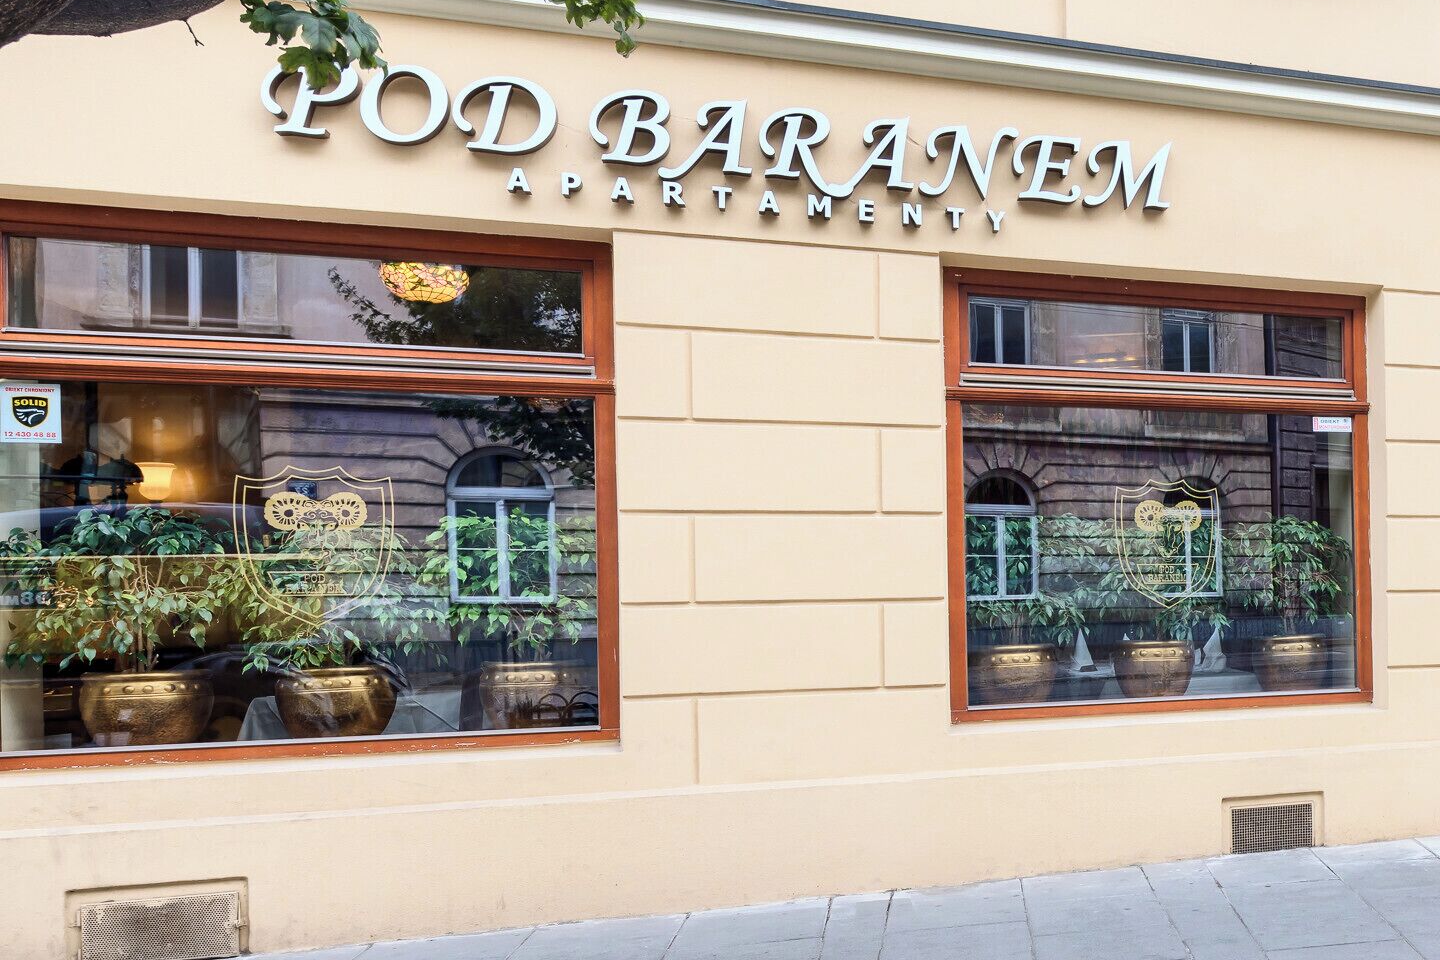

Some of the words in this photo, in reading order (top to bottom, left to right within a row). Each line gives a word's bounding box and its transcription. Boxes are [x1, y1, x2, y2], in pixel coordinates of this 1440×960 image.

[260, 61, 558, 156] POD
[588, 88, 1174, 212] BARANEM
[506, 166, 1007, 234] APARTAMENTY
[13, 398, 47, 407] SOLID
